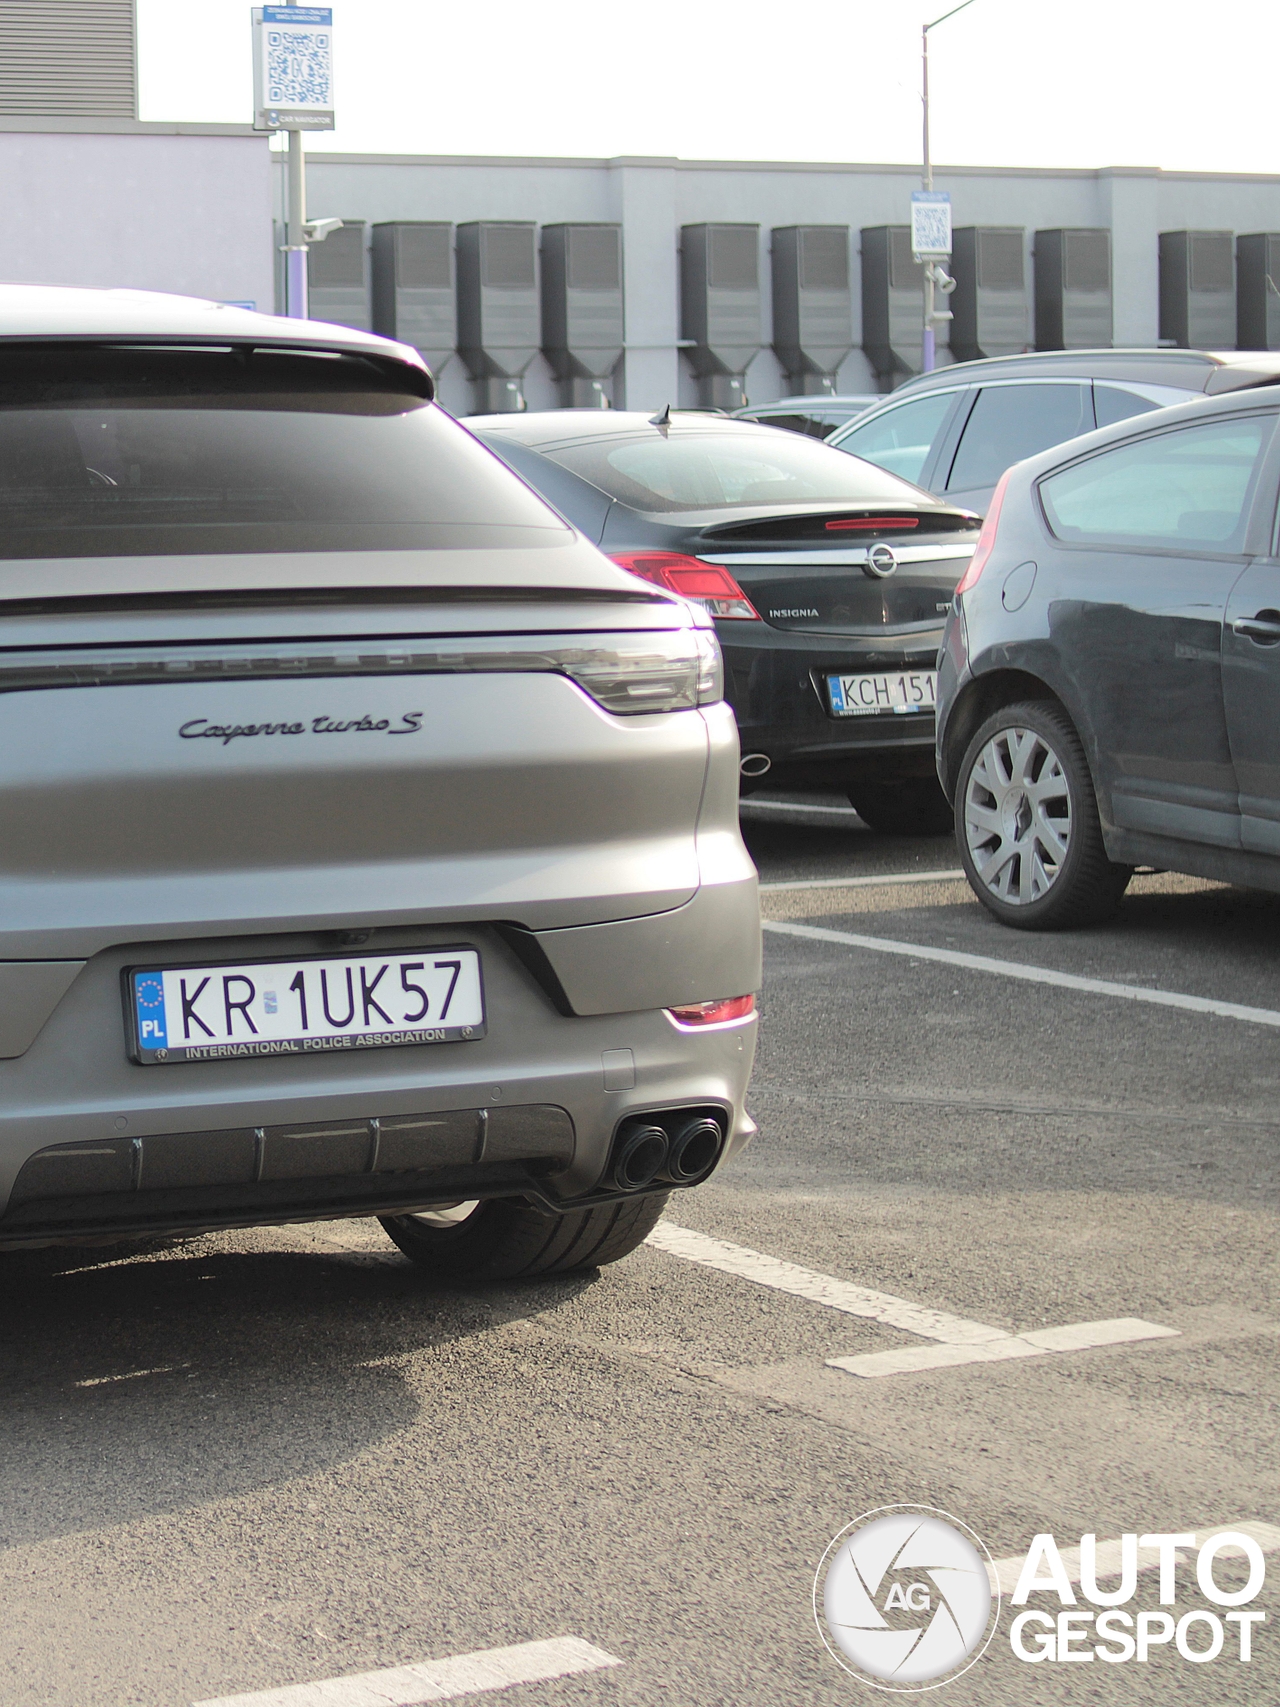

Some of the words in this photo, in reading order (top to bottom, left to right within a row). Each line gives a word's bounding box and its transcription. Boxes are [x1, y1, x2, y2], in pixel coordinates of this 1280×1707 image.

[769, 608, 820, 619] INSIGNIA
[832, 697, 843, 706] PL
[842, 676, 891, 707] KCH
[178, 718, 306, 746] Cayenne
[312, 714, 390, 734] turbo
[387, 711, 424, 735] S
[179, 974, 260, 1040] KR
[288, 959, 462, 1031] 1UK57
[141, 1019, 165, 1039] PL
[185, 1039, 299, 1060] INTERNATIONAL
[303, 1035, 352, 1051] POLICE
[355, 1028, 446, 1048] ASSOCIATION
